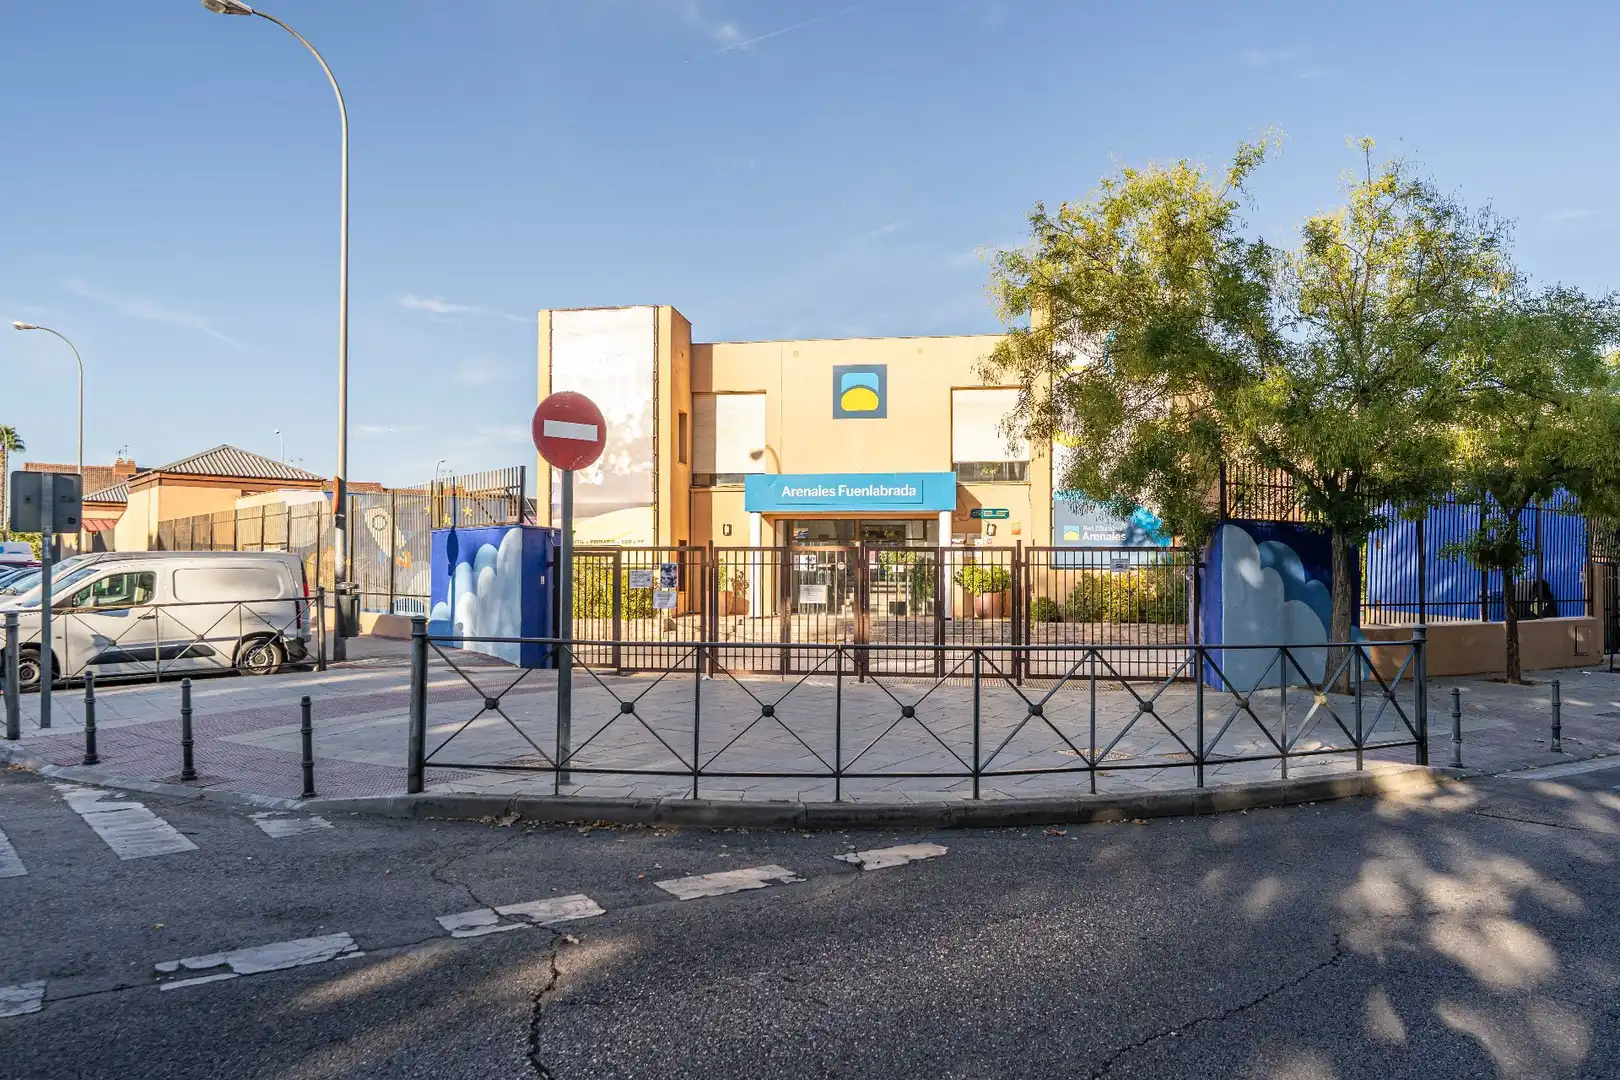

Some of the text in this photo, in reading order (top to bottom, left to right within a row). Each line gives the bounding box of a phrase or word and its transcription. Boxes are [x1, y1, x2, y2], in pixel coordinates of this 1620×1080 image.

[781, 484, 917, 497] Arenales Fuenlabrada
[1082, 531, 1126, 541] Arenales
